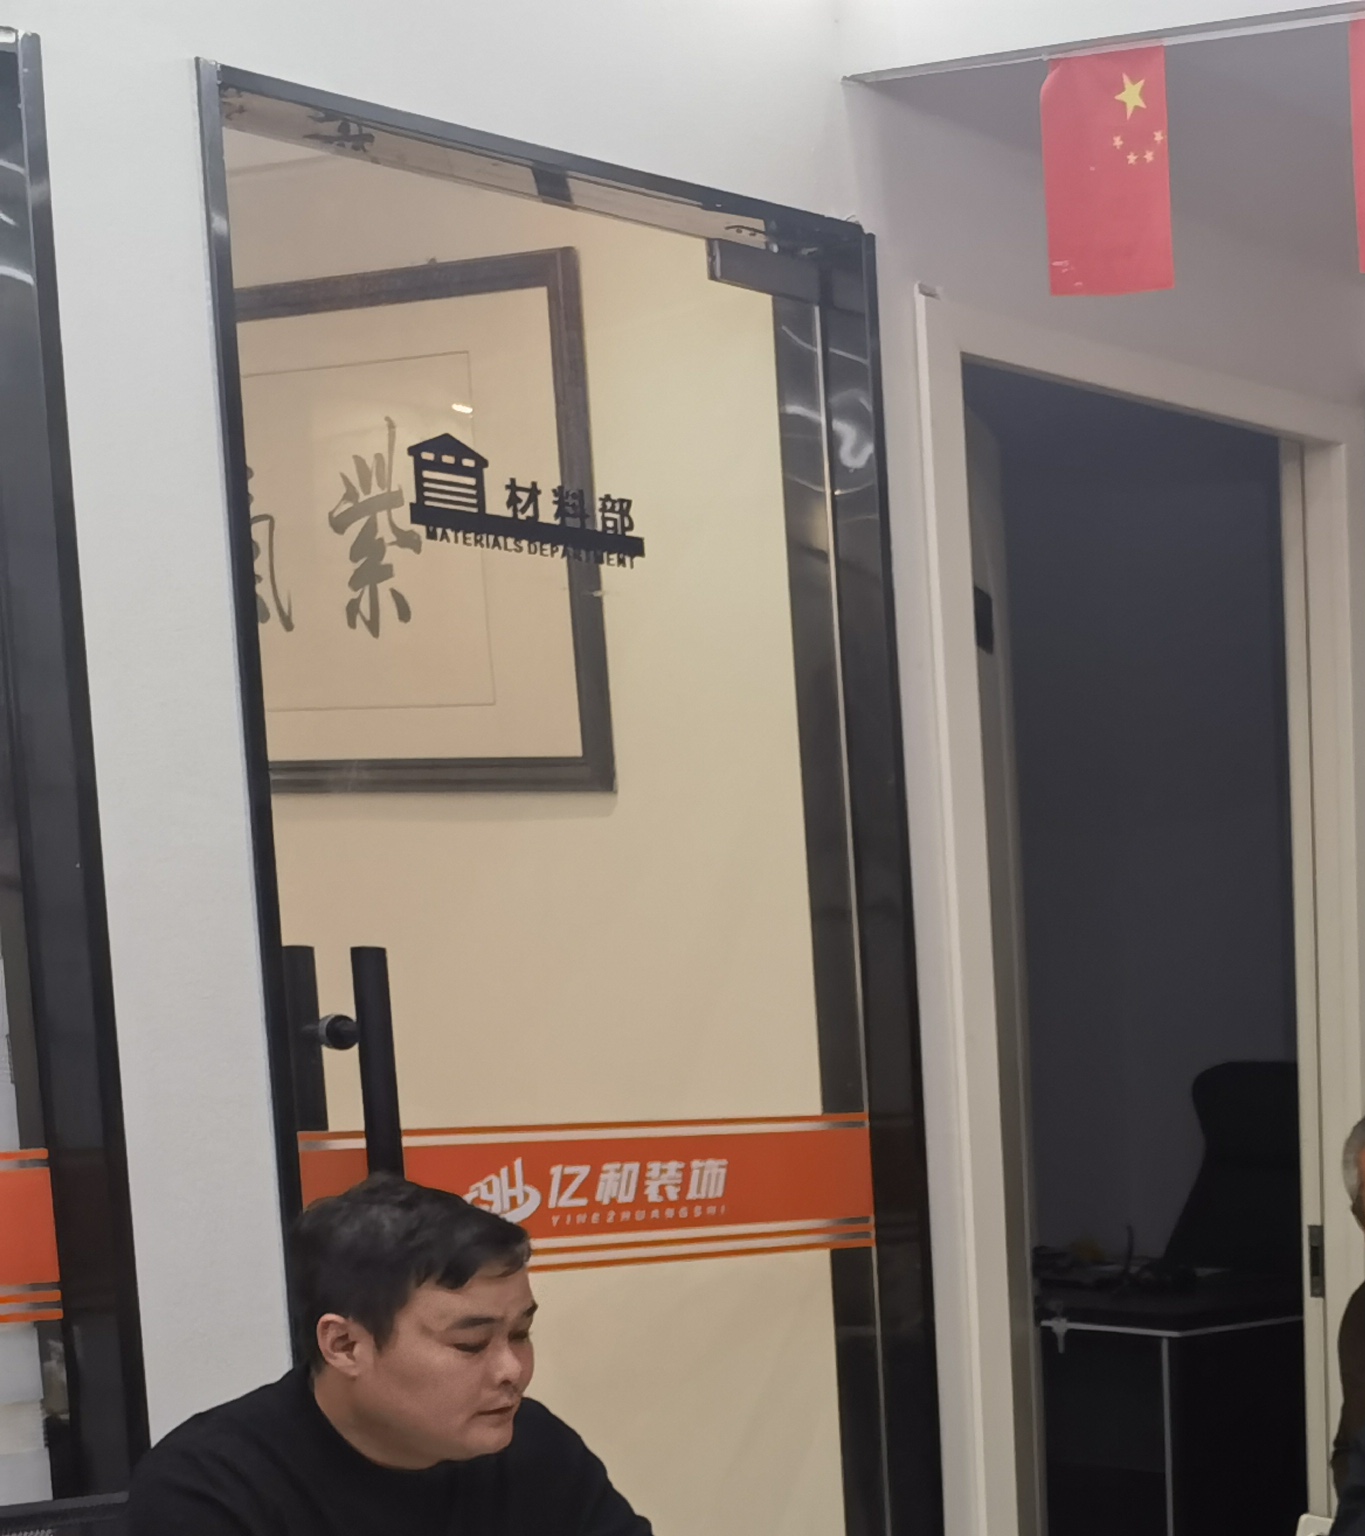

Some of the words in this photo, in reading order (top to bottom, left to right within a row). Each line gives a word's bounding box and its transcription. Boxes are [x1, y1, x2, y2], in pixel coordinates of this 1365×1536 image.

[505, 478, 634, 534] 材料部
[426, 525, 523, 553] MATERIALS
[548, 1159, 728, 1208] 亿和装饰
